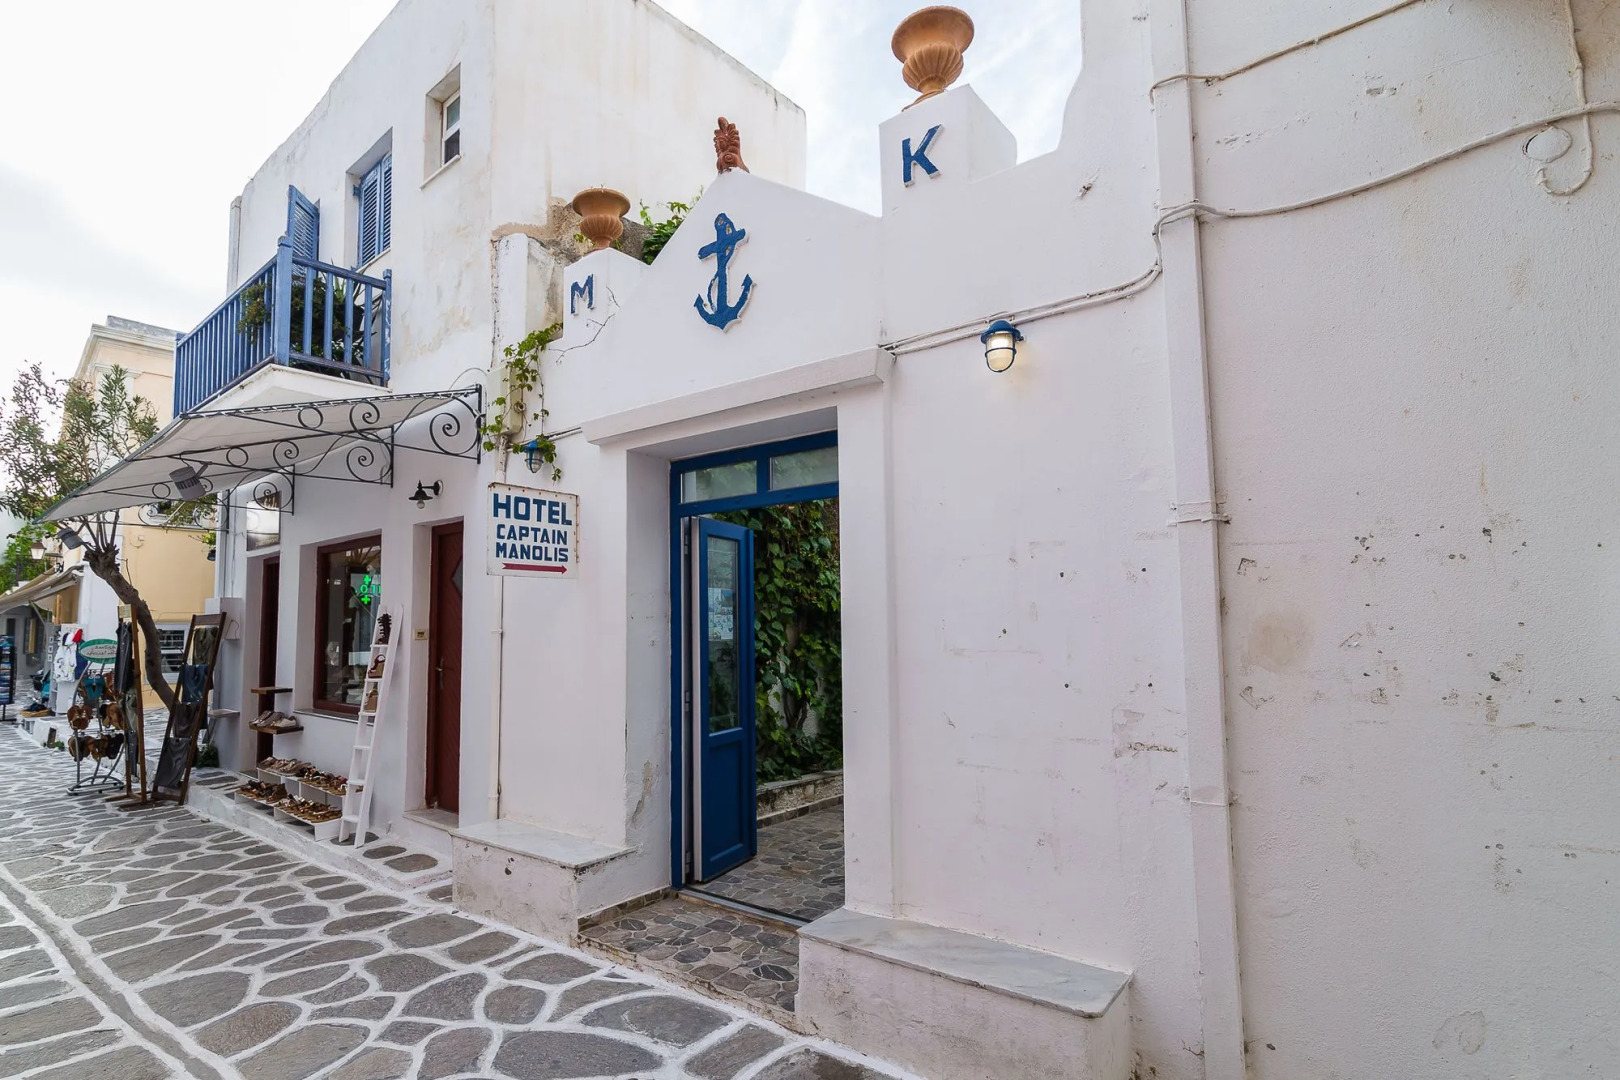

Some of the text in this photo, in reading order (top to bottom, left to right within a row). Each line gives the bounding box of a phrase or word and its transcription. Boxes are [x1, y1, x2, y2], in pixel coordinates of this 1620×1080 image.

[901, 124, 942, 184] K
[570, 273, 594, 314] M
[493, 493, 572, 526] HOTEL
[496, 523, 567, 545] CAPTAIN
[495, 541, 569, 562] MANOLIS
